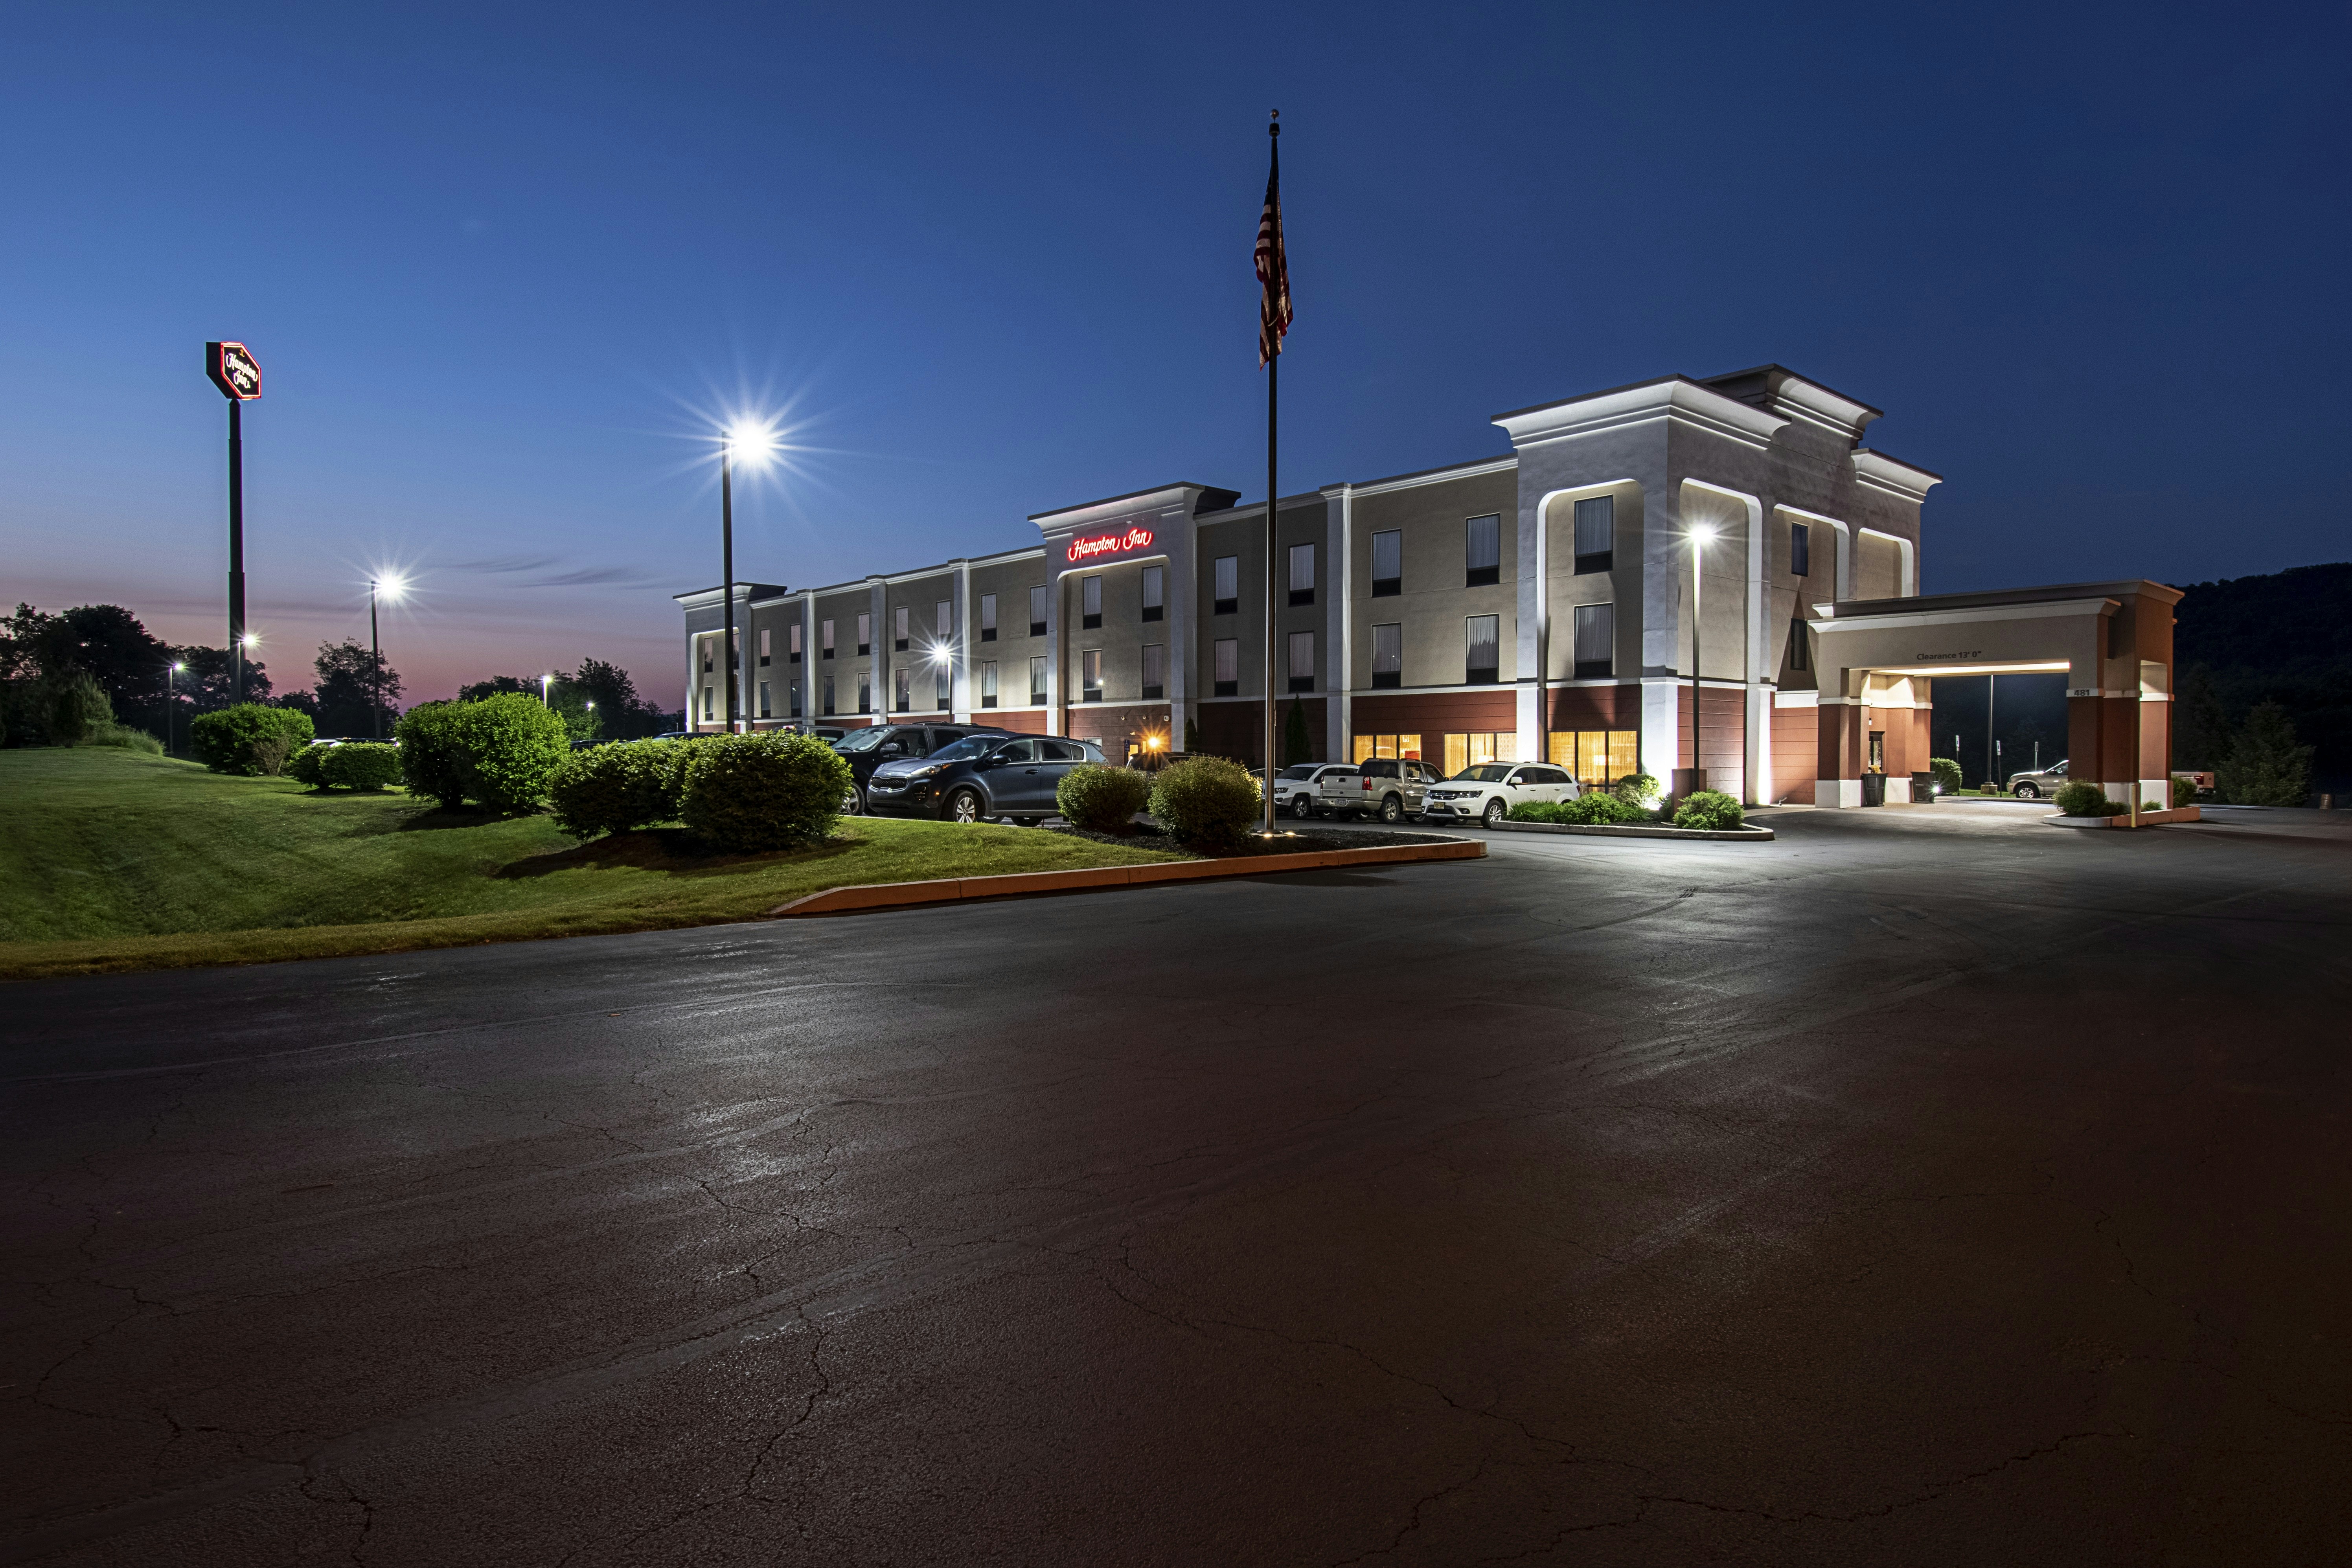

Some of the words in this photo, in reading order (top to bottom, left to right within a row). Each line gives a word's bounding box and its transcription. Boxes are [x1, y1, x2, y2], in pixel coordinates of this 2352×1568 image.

[226, 353, 258, 382] Hampton
[1068, 536, 1121, 561] Hampton
[1122, 529, 1152, 550] Inn
